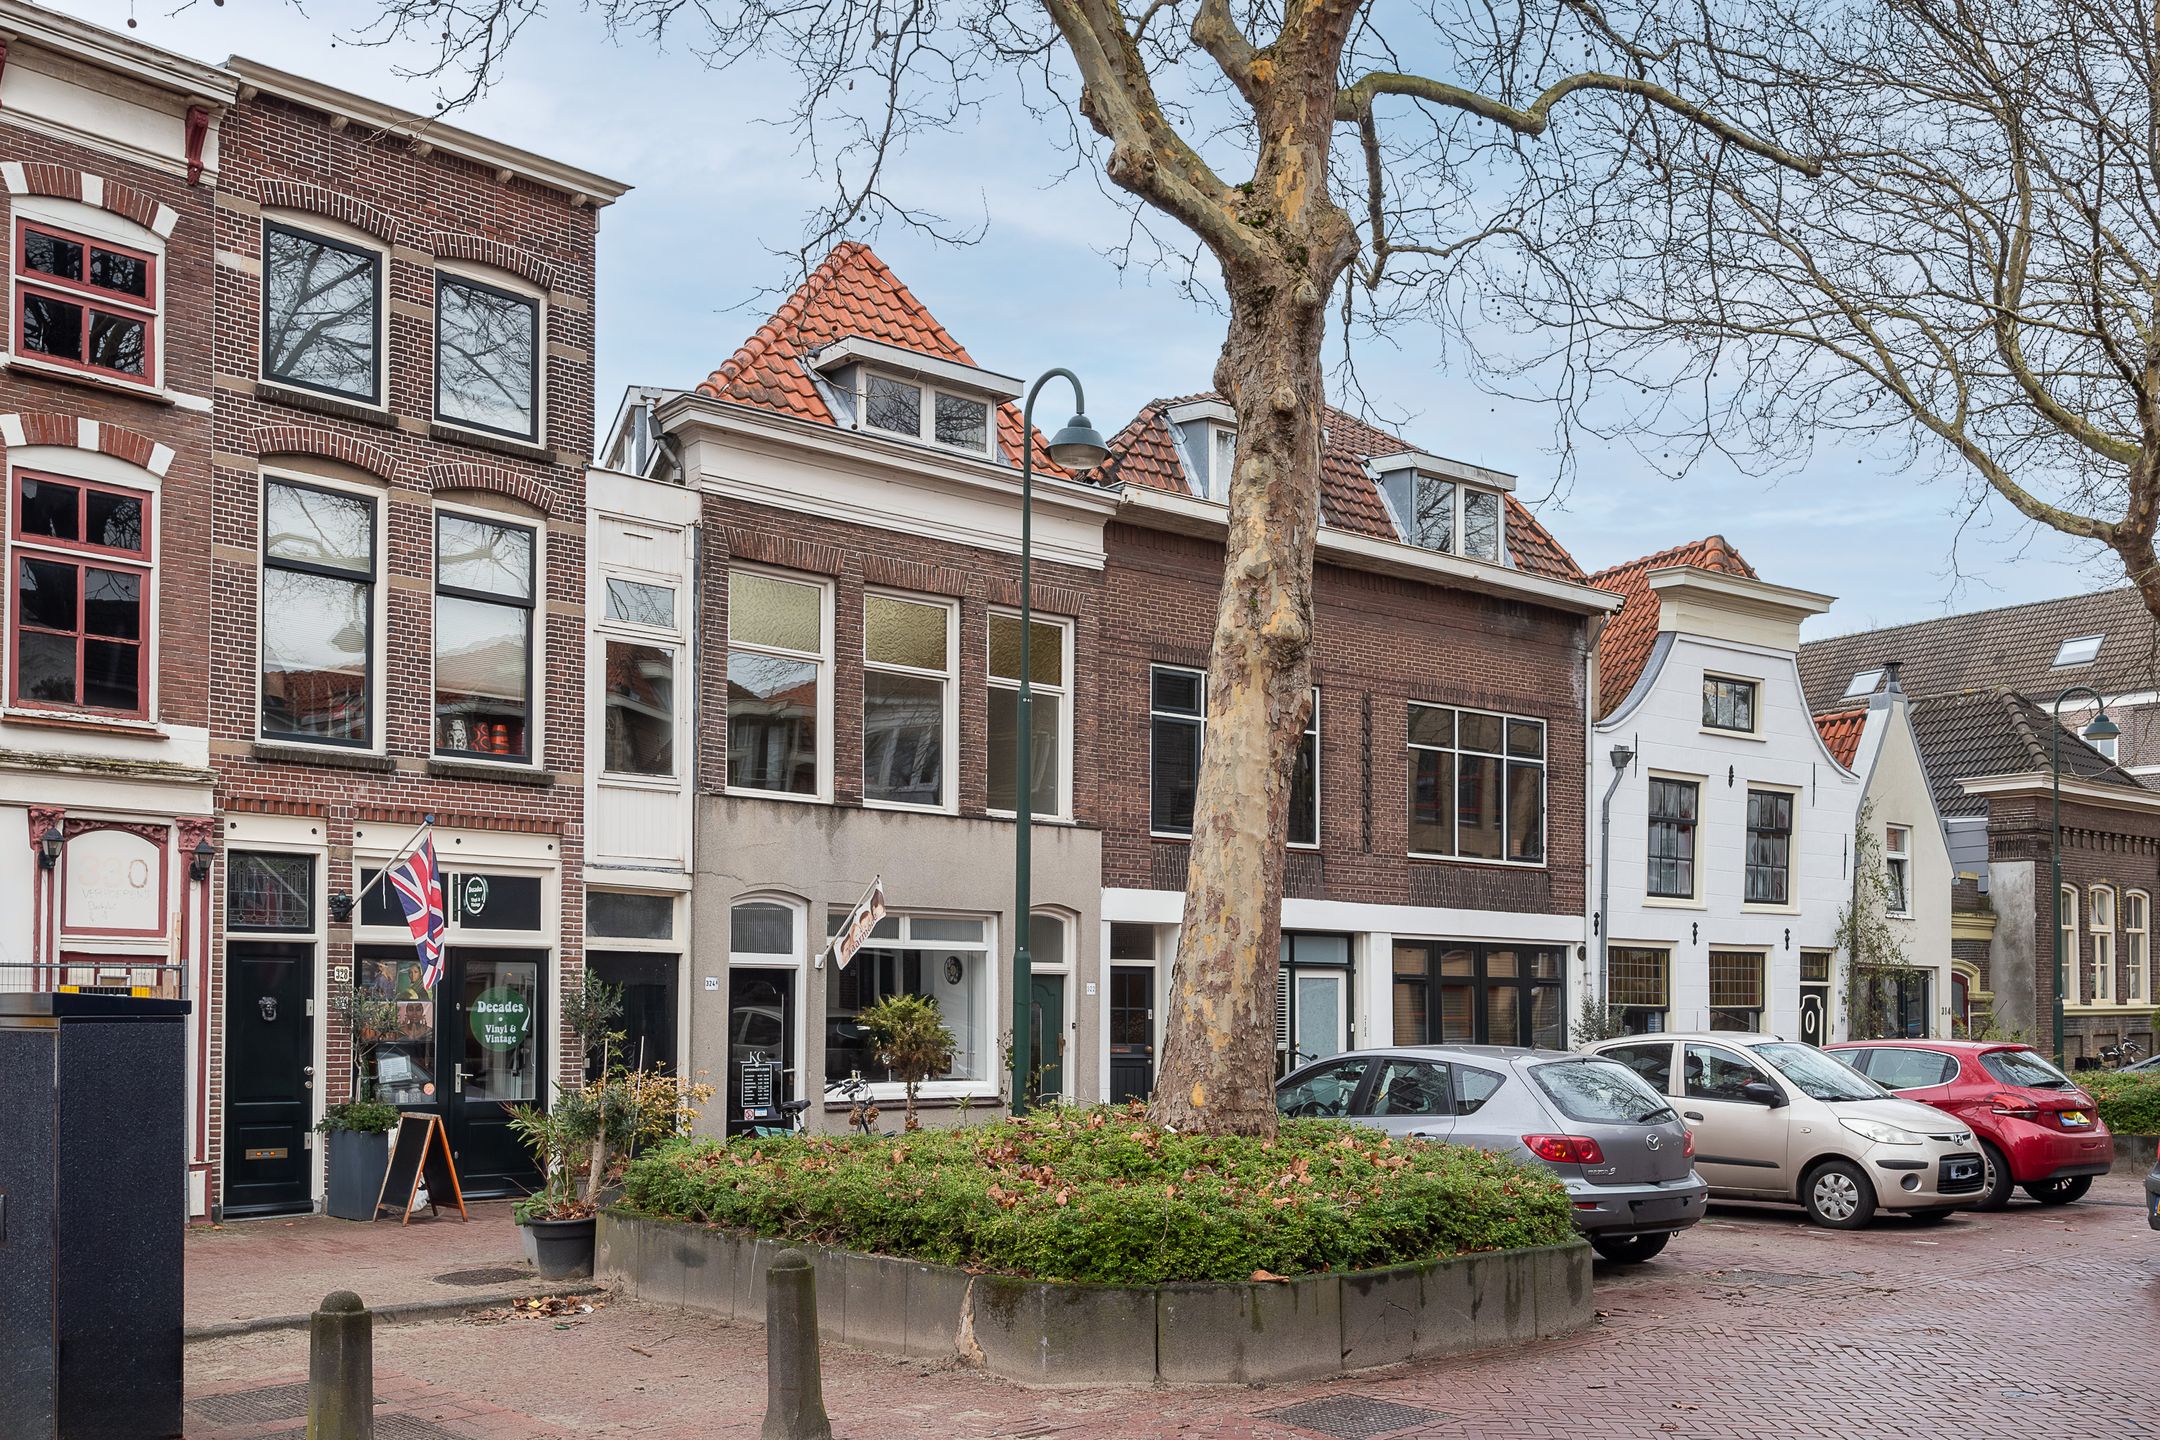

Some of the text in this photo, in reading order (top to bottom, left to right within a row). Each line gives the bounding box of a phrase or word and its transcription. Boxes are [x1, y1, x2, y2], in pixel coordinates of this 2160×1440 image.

[336, 968, 348, 980] 328
[477, 1001, 524, 1013] Decades
[485, 1024, 517, 1034] Vinyl &
[484, 1034, 517, 1045] Vintage
